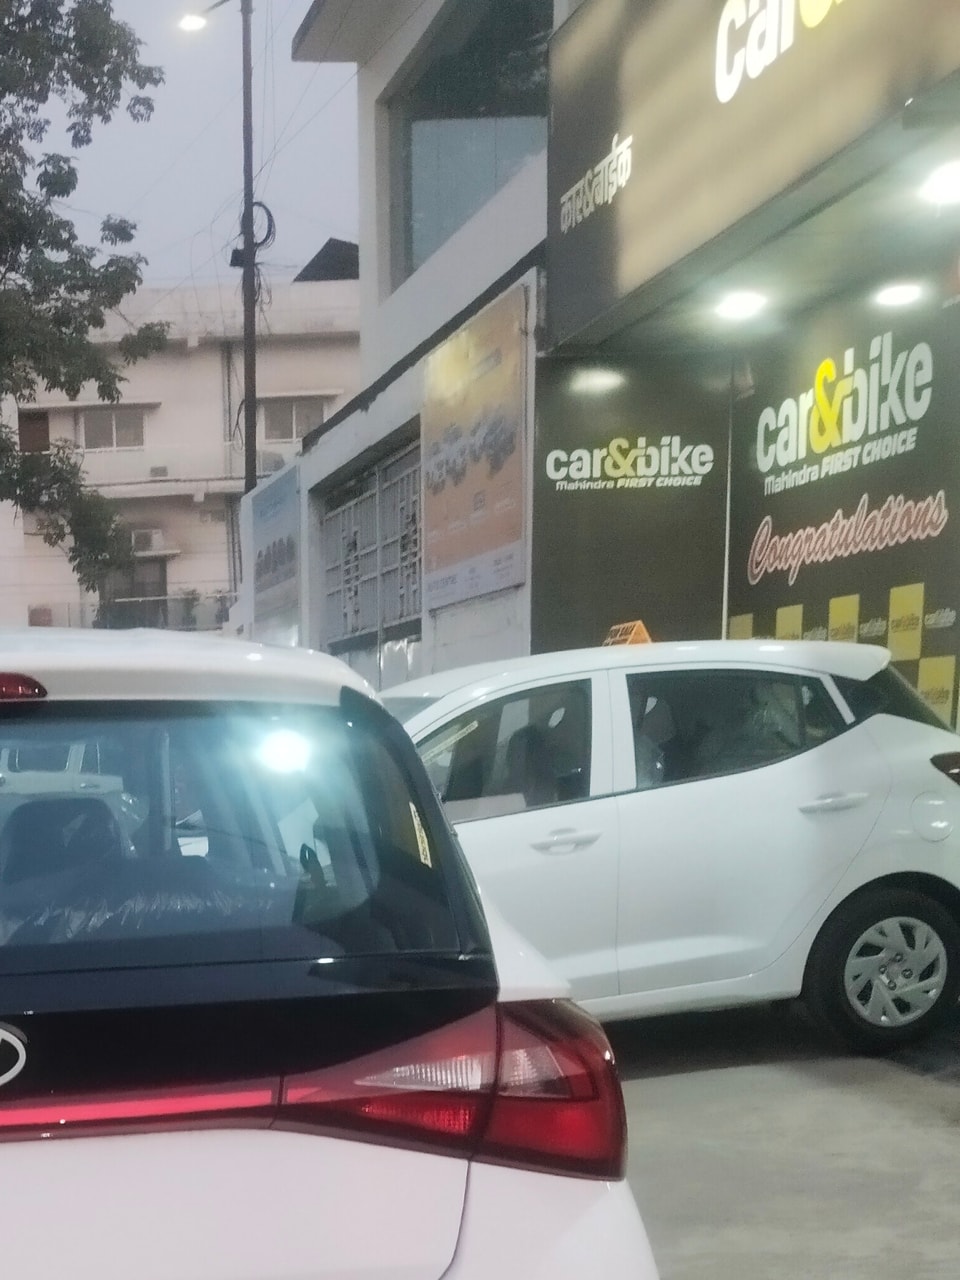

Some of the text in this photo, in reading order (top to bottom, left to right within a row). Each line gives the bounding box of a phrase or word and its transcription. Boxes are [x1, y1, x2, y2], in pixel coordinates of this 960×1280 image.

[756, 331, 933, 473] car&bike
[546, 435, 714, 480] car&bike
[555, 475, 703, 491] Mahindra FIRST CHOICE
[764, 427, 919, 496] Mahindra FIRST CHOICE
[747, 489, 949, 586] Congratulations
